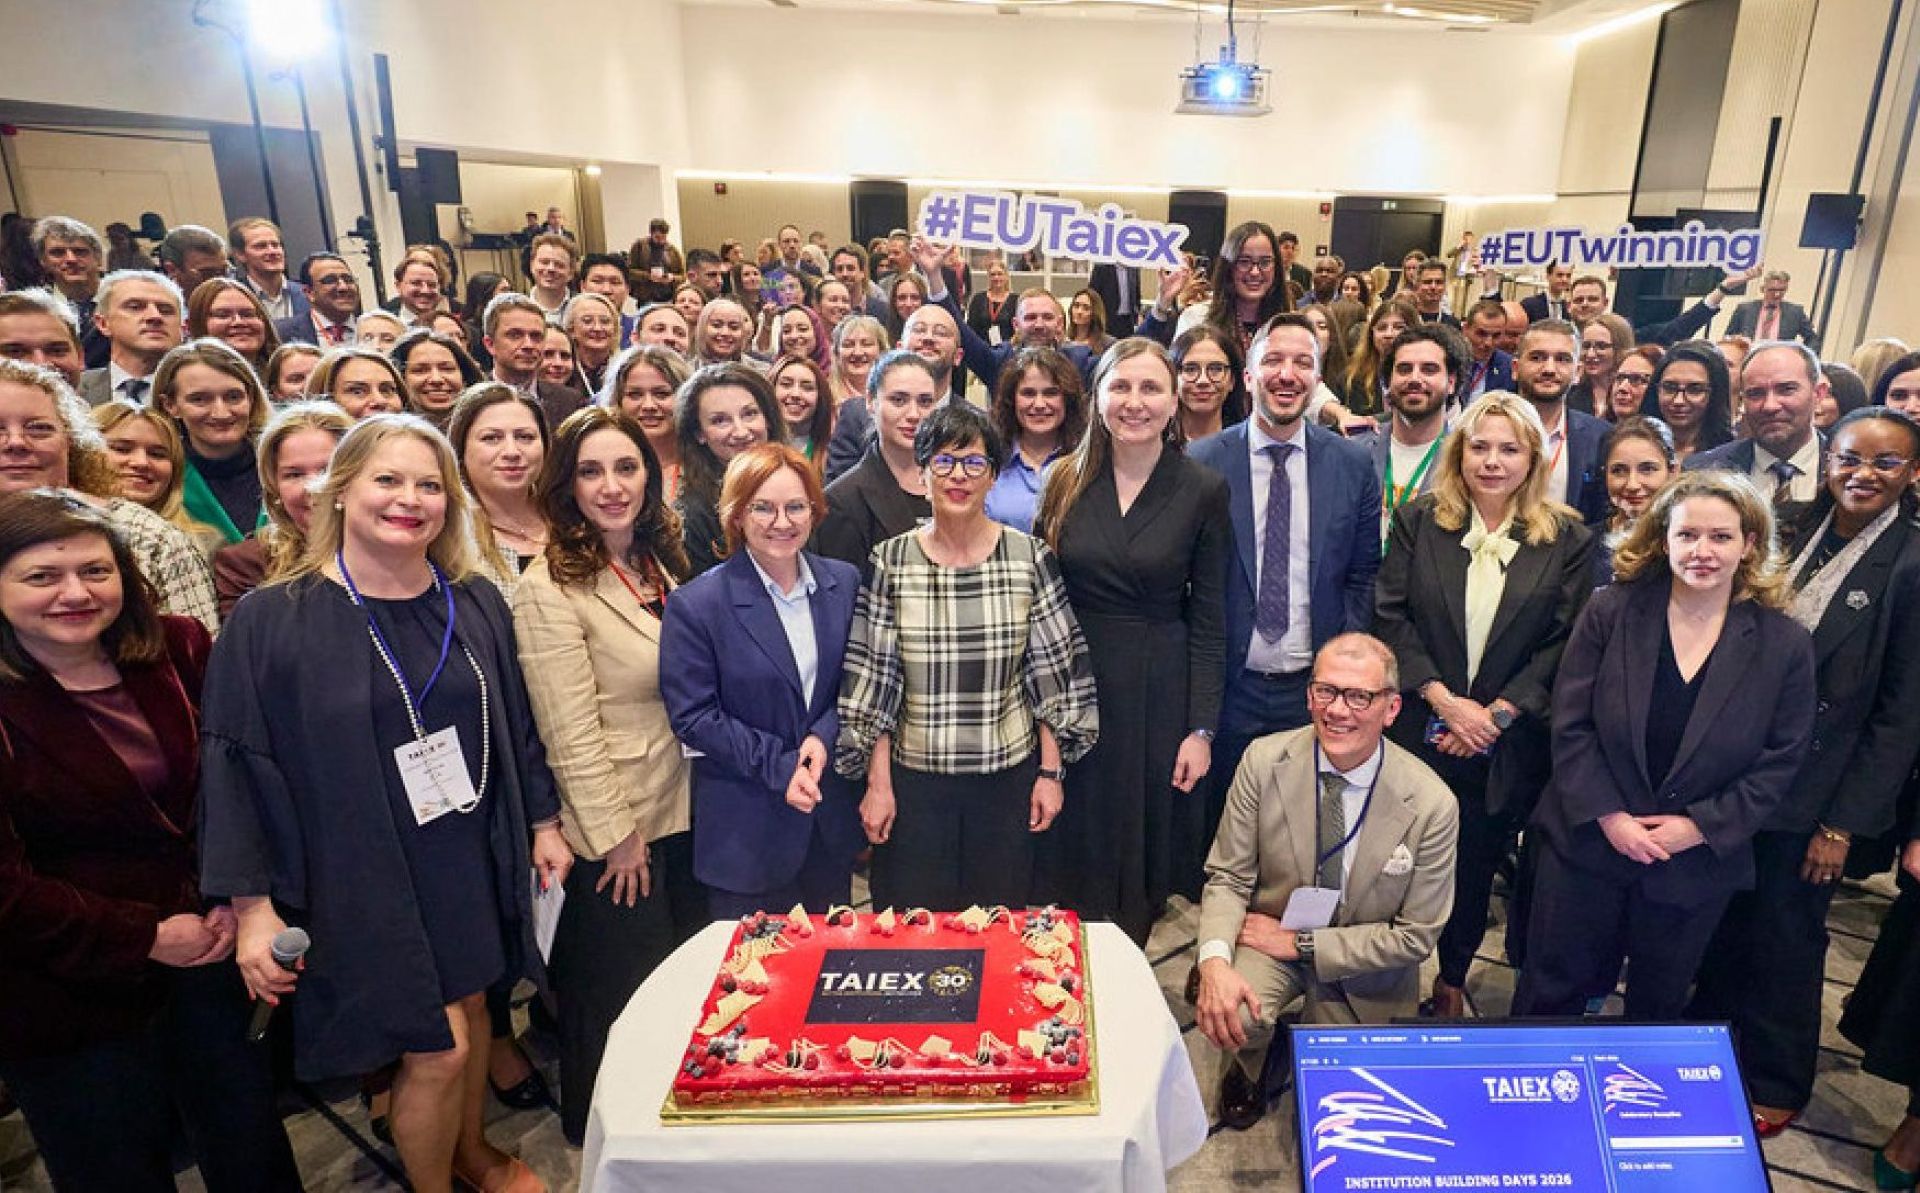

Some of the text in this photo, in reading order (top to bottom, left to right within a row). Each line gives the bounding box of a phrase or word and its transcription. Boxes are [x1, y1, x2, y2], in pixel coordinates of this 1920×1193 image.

[924, 193, 1180, 265] #EUTaiex
[1480, 226, 1760, 269] #EUTwinning
[820, 972, 925, 991] TAIEX
[1482, 1077, 1551, 1098] TAIEX
[1345, 1176, 1431, 1189] INSTITUTION
[1435, 1175, 1499, 1188] BUILDING
[1502, 1174, 1537, 1187] DAYS
